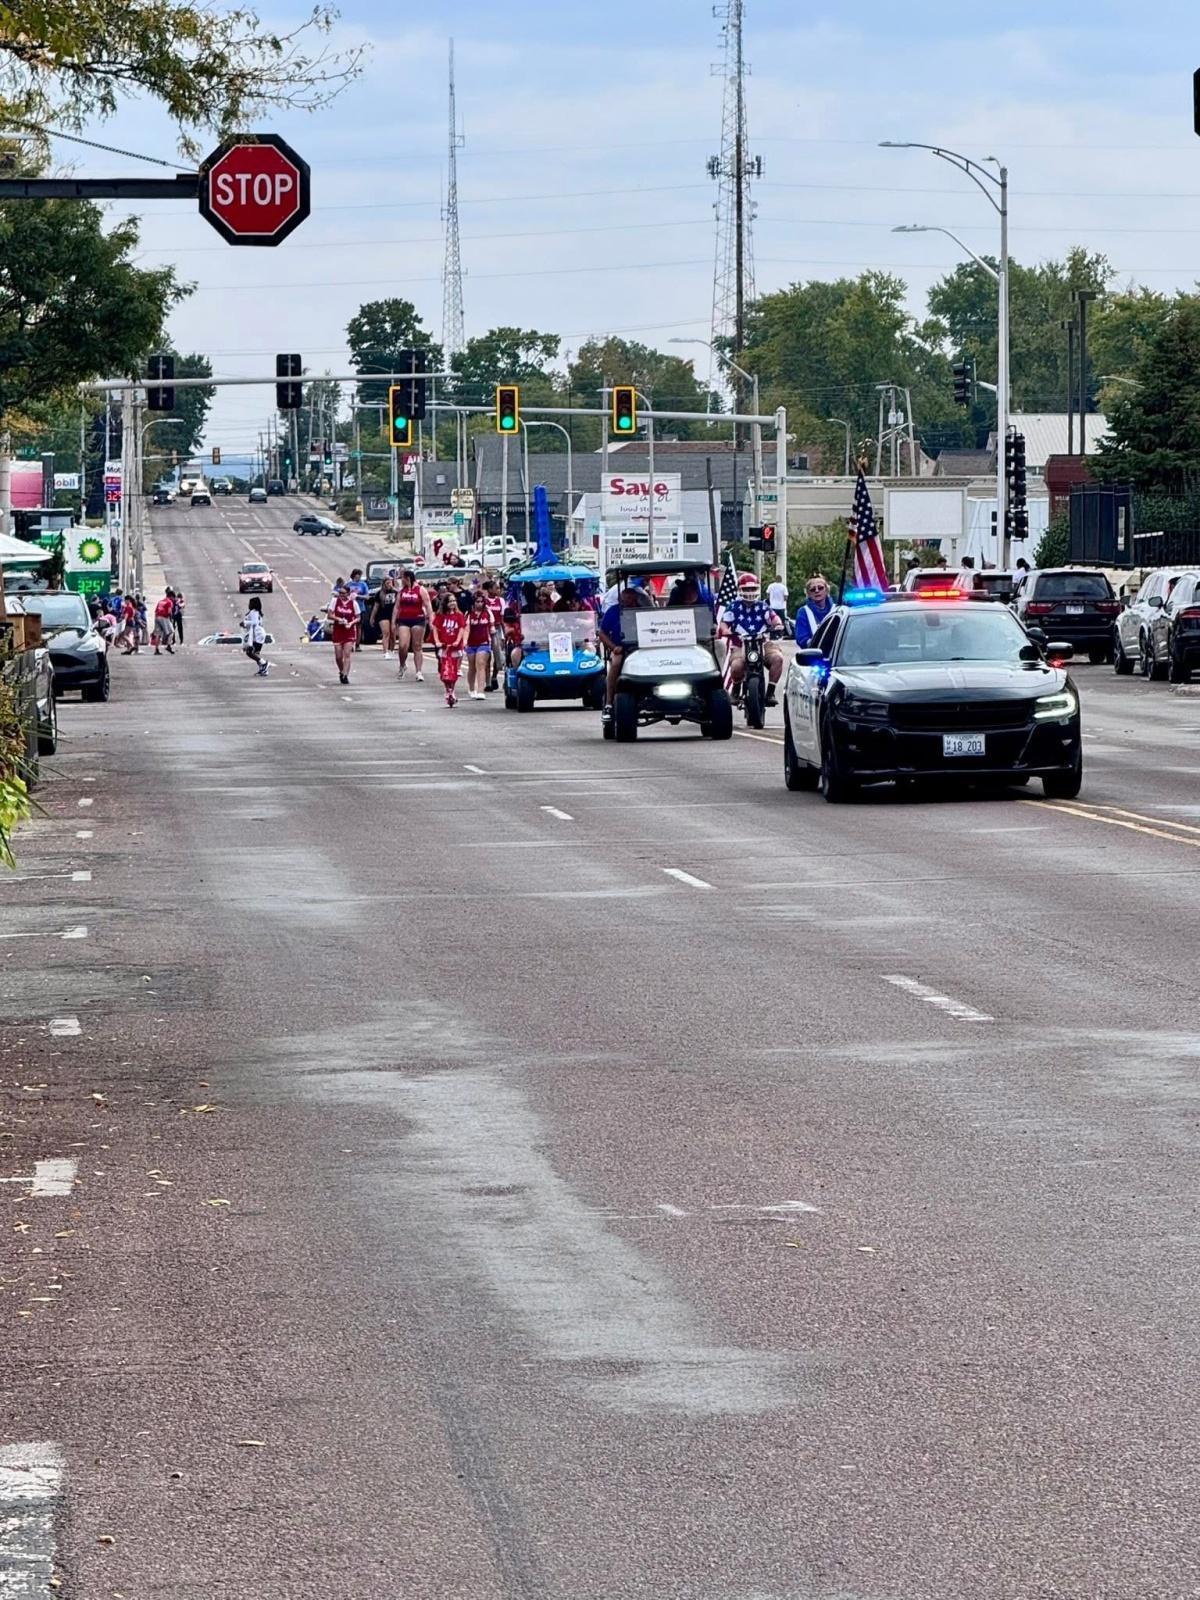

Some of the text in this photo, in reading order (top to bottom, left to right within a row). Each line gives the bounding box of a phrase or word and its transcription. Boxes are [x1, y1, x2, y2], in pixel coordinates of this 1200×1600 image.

[216, 173, 293, 205] STOP
[56, 479, 75, 487] obil
[610, 478, 669, 496] Save
[953, 741, 982, 752] 18 203
